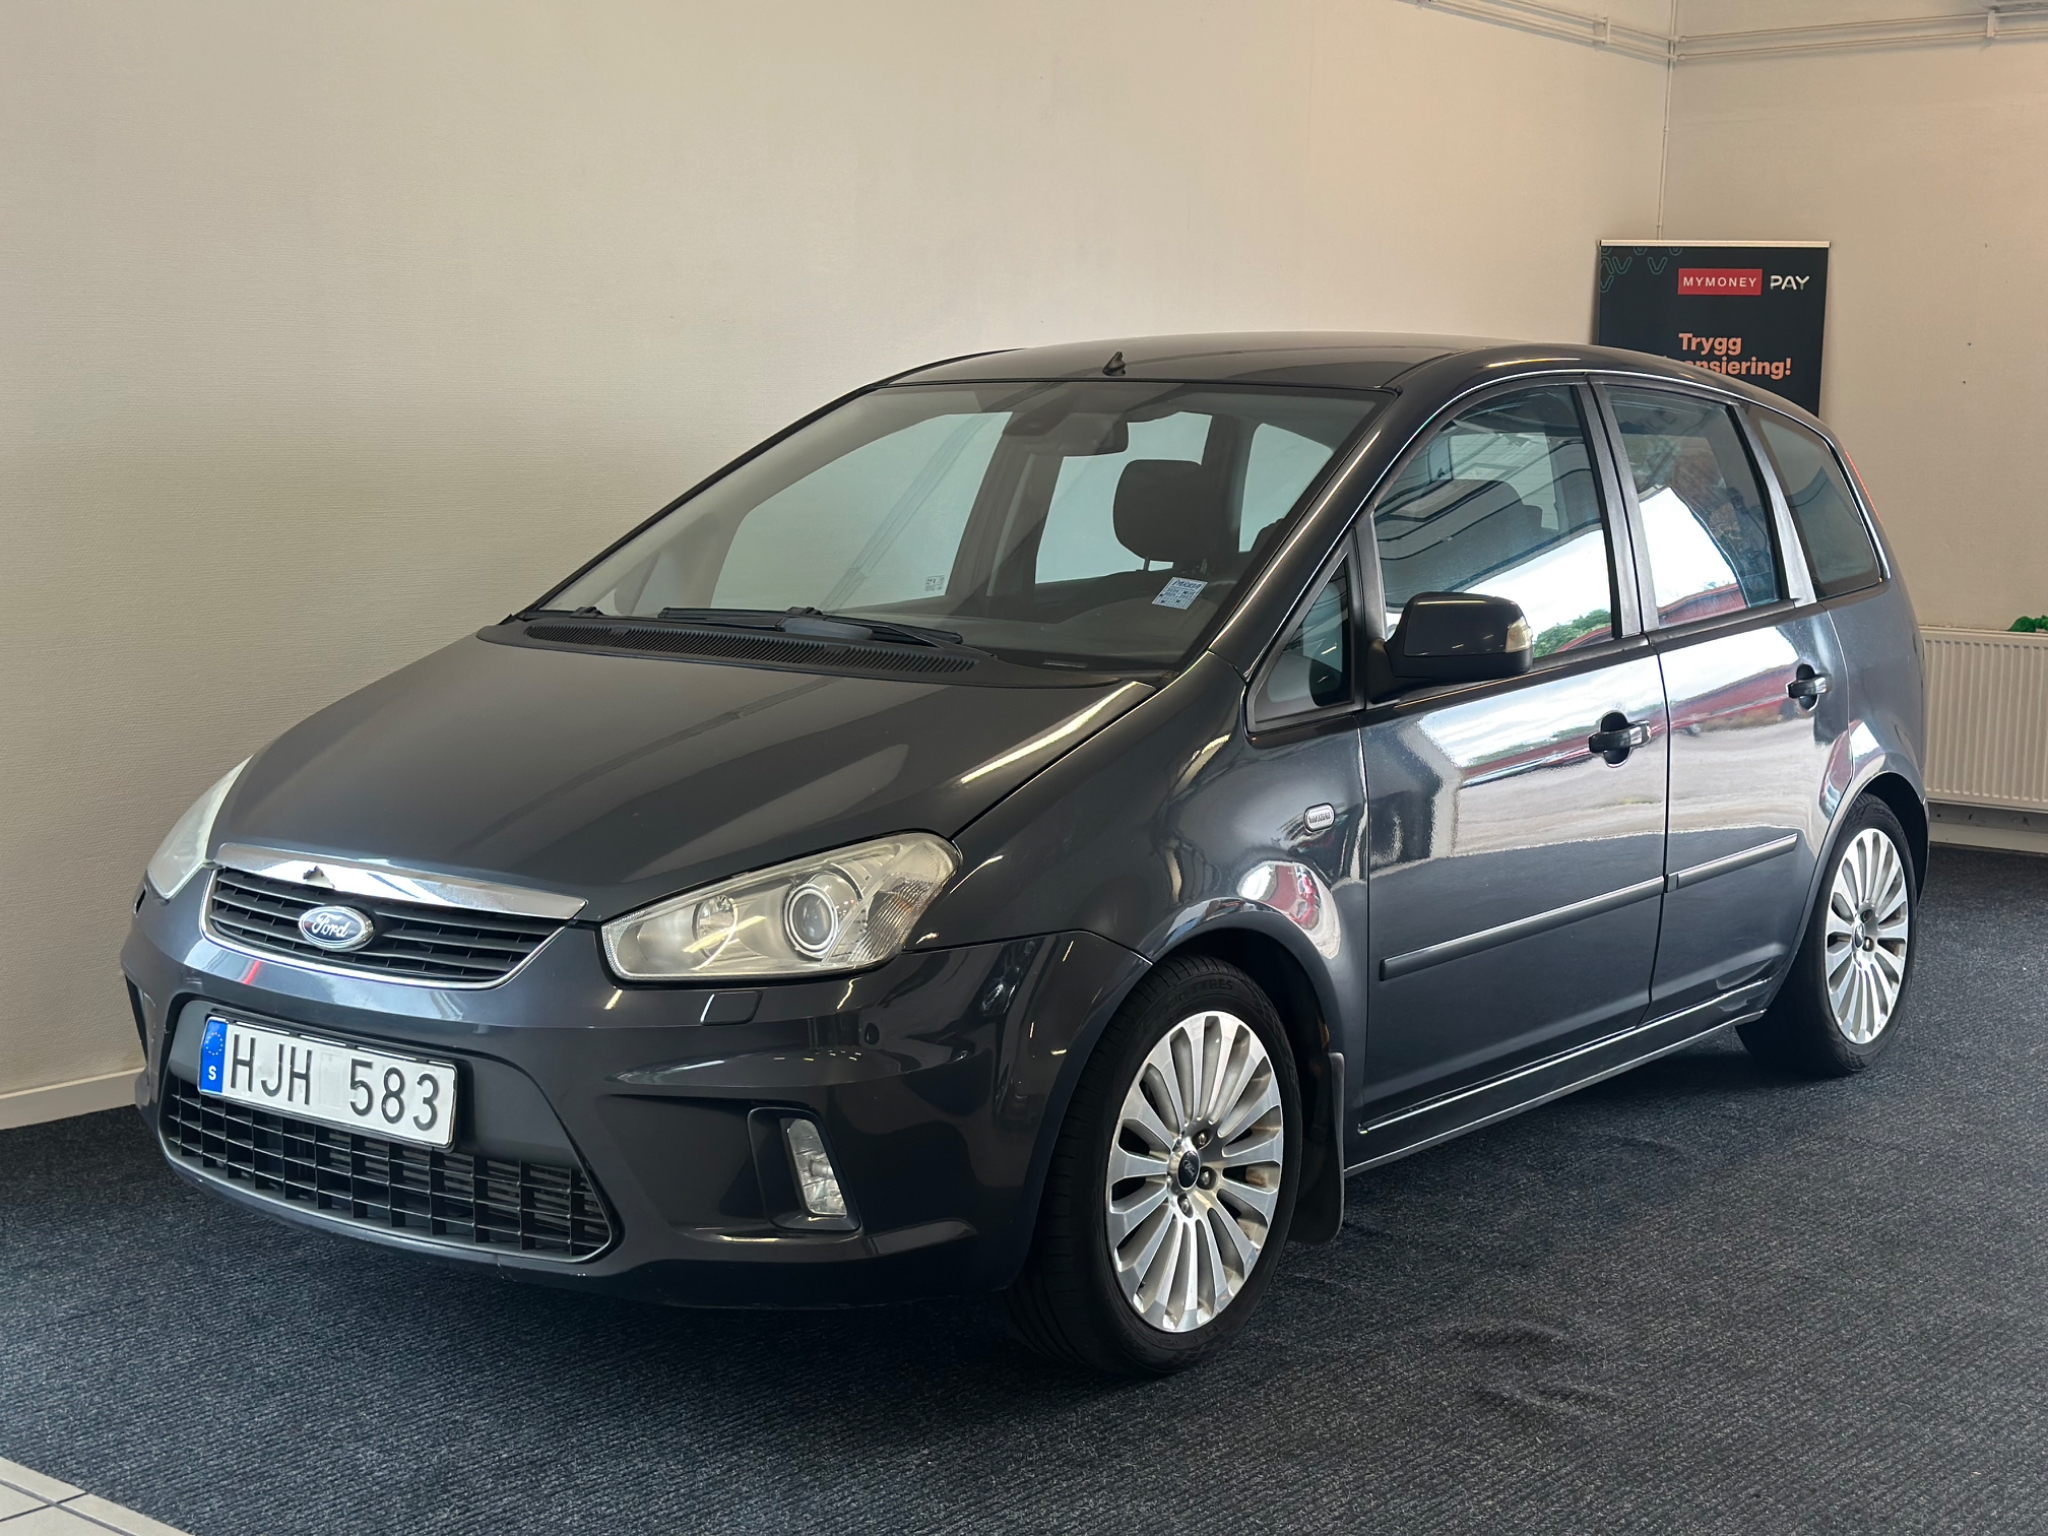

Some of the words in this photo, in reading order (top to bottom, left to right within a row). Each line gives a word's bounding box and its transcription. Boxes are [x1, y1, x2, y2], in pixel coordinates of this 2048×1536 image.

[1682, 276, 1757, 288] MYMONEY
[1770, 275, 1810, 290] PAY
[1678, 332, 1742, 356] Trygg
[311, 912, 351, 938] Ford
[207, 1065, 217, 1081] S
[230, 1033, 313, 1106] HJH
[349, 1057, 440, 1132] 583
